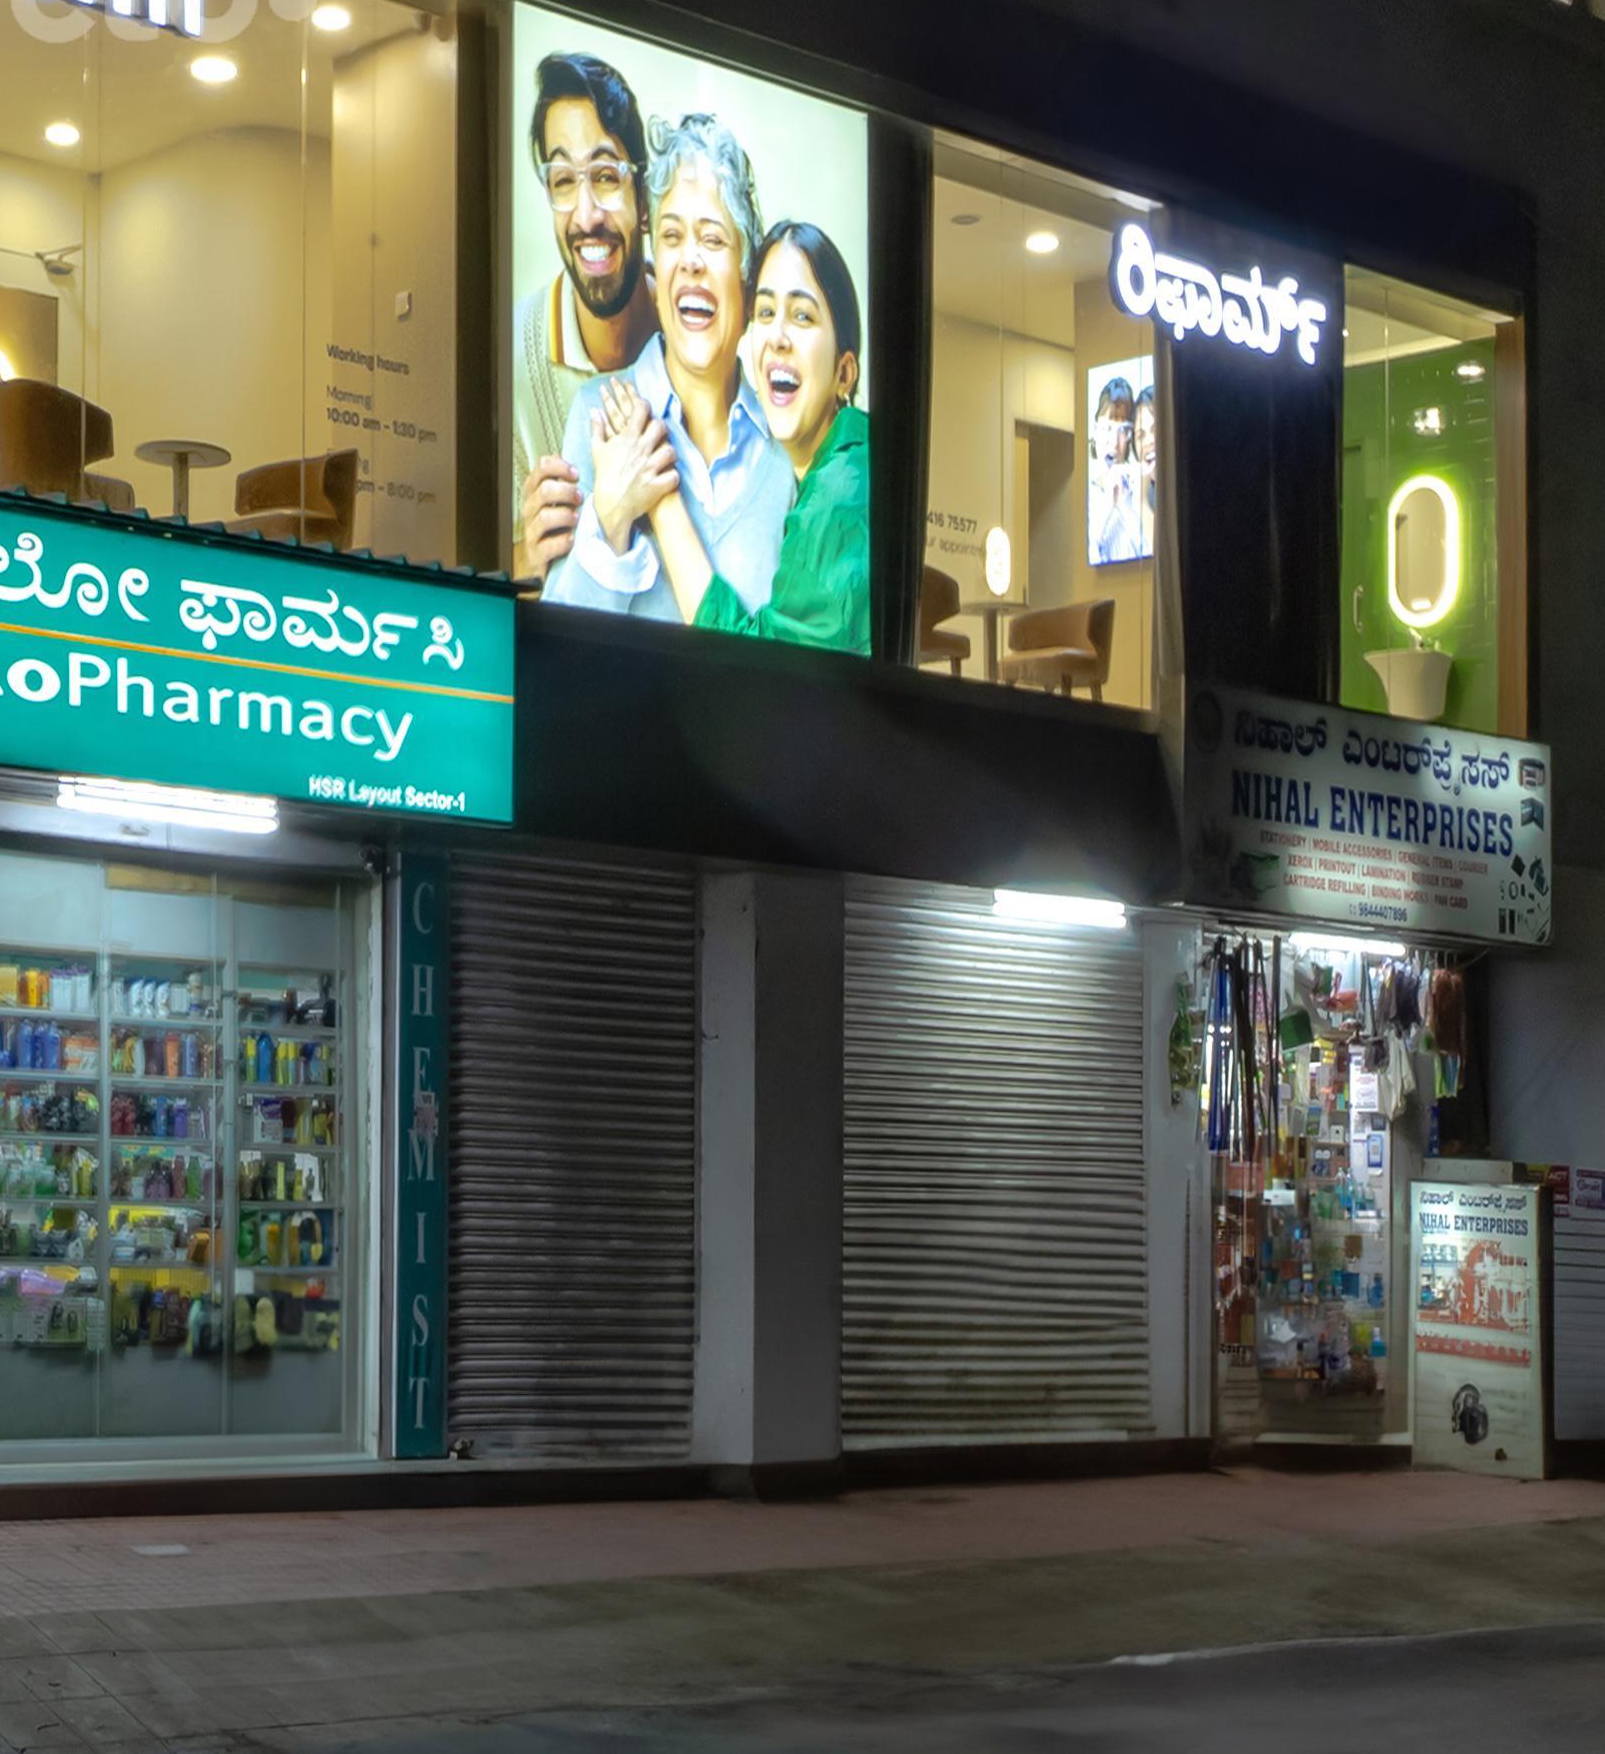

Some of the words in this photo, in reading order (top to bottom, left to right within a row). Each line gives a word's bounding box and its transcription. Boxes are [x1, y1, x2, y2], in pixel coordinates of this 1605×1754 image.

[326, 344, 375, 372] Working
[377, 355, 410, 375] hours
[326, 384, 373, 411] Morning
[326, 407, 360, 427] 10:00
[179, 578, 465, 671] ಫಾರ್ಮಸಿ
[309, 775, 345, 798] HSR
[349, 782, 402, 809] Layout
[405, 788, 466, 812] Sector-1
[1231, 769, 1319, 829] NIHAL
[1329, 785, 1514, 857] ENTERPRISES
[1260, 830, 1307, 848] STATIONERY
[1312, 838, 1340, 854] MOBILE
[1343, 843, 1392, 862] ACCESSORIES
[1288, 854, 1313, 869] XEROX
[1318, 858, 1356, 876] PRINTOUT
[1361, 865, 1406, 882] LAMINATION
[1283, 873, 1326, 892] CARTRIDGE
[1327, 878, 1366, 896] REFILLING
[1419, 1212, 1451, 1230] NIHAL
[1454, 1215, 1529, 1236] ENTERPRISES
